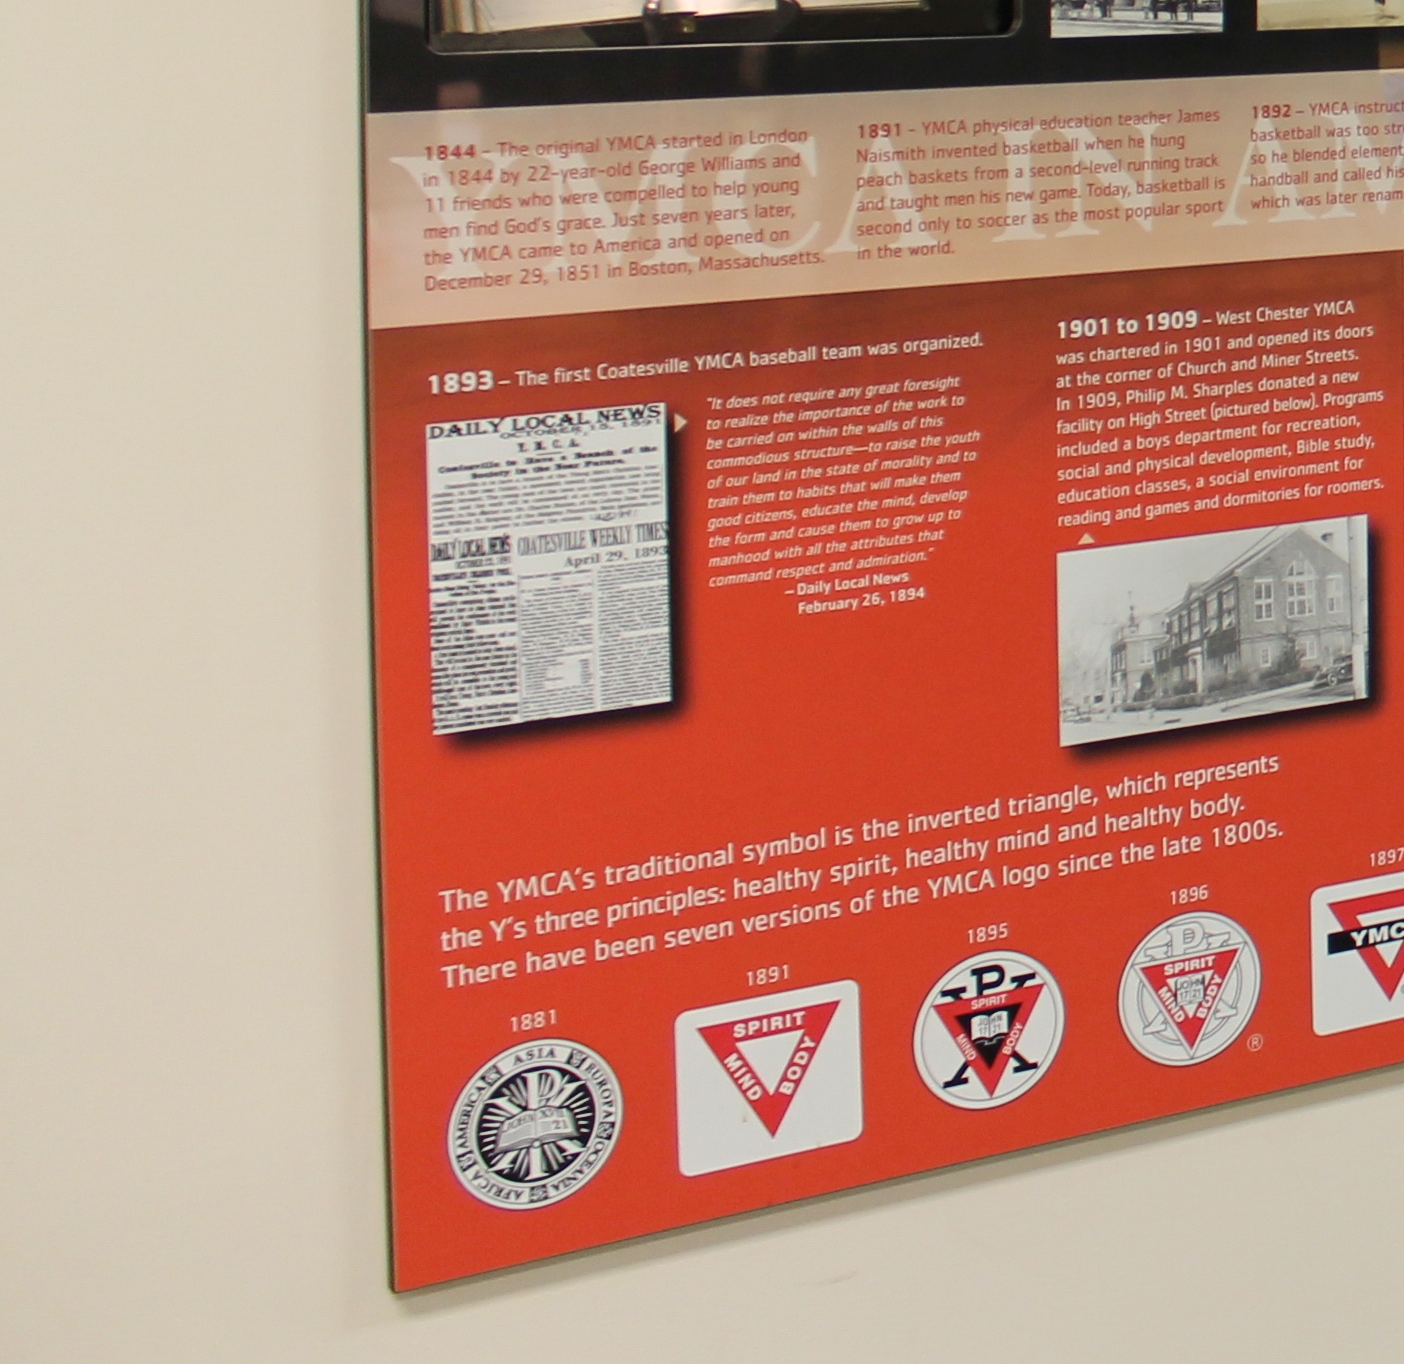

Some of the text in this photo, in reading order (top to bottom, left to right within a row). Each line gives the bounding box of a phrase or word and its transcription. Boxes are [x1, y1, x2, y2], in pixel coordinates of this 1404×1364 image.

[388, 131, 940, 279] YMCA
[993, 110, 1172, 243] IN
[427, 369, 494, 394] 1893
[428, 403, 662, 440] DAILY LOCAL NEWS
[516, 522, 669, 557] COATESVILLE WEEKLY TIMES
[564, 553, 600, 569] April
[634, 546, 668, 559] 1893
[1169, 883, 1209, 905] 1896
[967, 921, 1008, 944] 1895
[746, 963, 789, 987] 1891
[509, 1008, 557, 1033] 1881
[732, 1010, 806, 1038] SPIRIT
[723, 1052, 764, 1102] MIND
[778, 1035, 817, 1096] BODY
